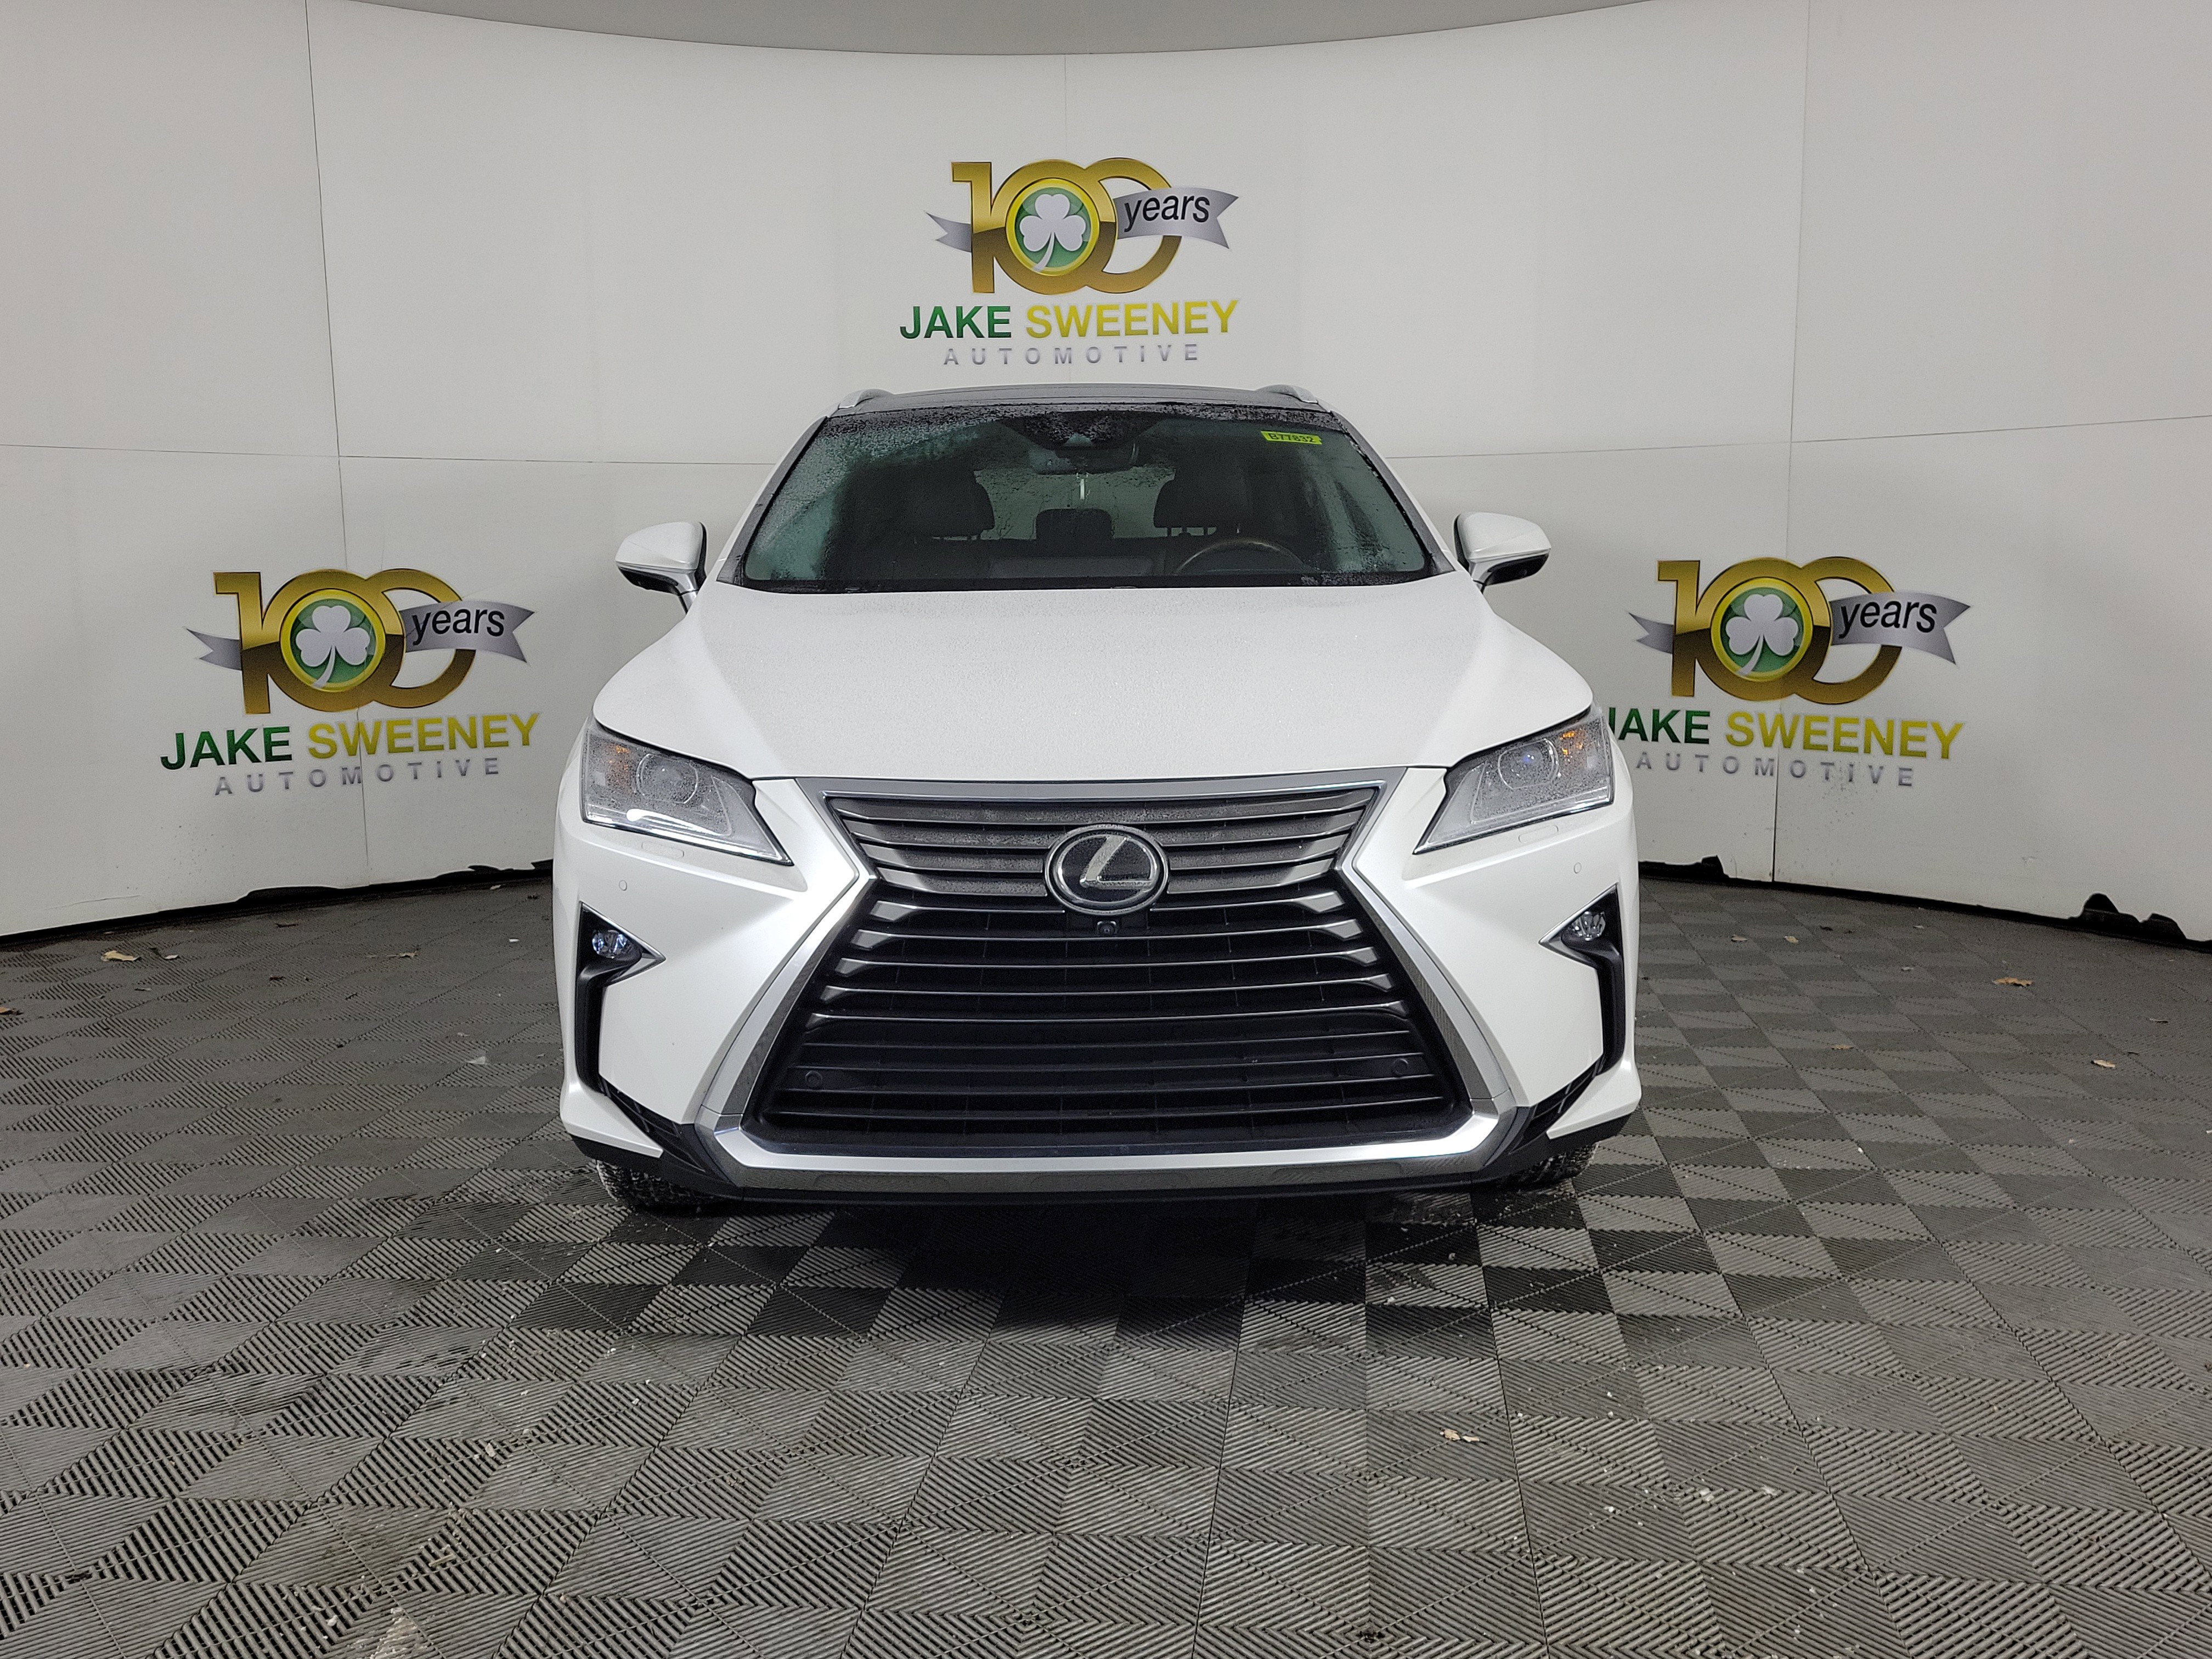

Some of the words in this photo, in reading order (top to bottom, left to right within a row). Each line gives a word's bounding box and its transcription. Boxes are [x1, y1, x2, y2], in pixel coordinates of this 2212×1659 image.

[951, 157, 1182, 295] 100
[1124, 195, 1210, 232] years
[900, 306, 1012, 339] JAKE
[1026, 300, 1238, 338] SWEENEY
[944, 343, 1198, 365] AUTOMOTIVE
[213, 568, 476, 714] 100
[413, 608, 505, 646] years
[1657, 556, 1902, 704] 100
[1839, 600, 1937, 639] years
[160, 726, 292, 770] JAKE
[308, 713, 541, 759] SWEENEY
[1725, 712, 1964, 759] SWEENEY
[214, 758, 499, 795] AUTOMOTIVE
[1636, 751, 1913, 787] AUTOMOTIVE
